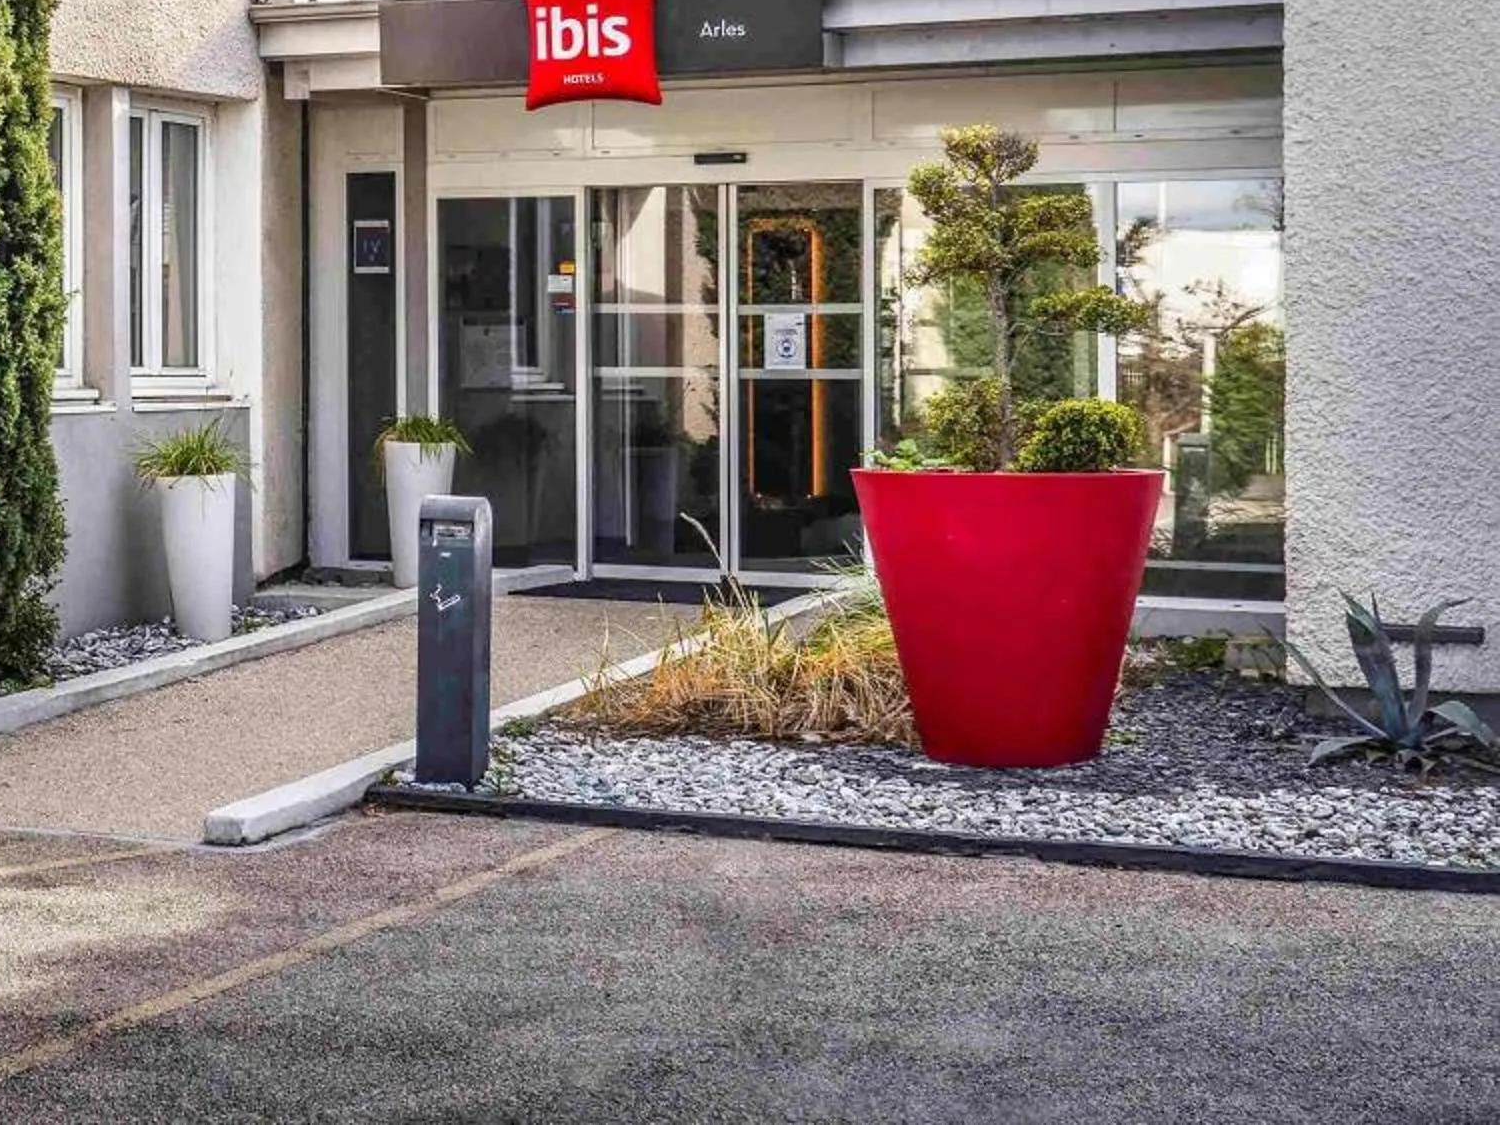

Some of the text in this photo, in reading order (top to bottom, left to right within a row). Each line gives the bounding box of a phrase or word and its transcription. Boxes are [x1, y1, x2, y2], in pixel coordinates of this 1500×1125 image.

[535, 3, 632, 61] ibis
[699, 18, 747, 38] Arles
[563, 72, 604, 84] HOTELS
